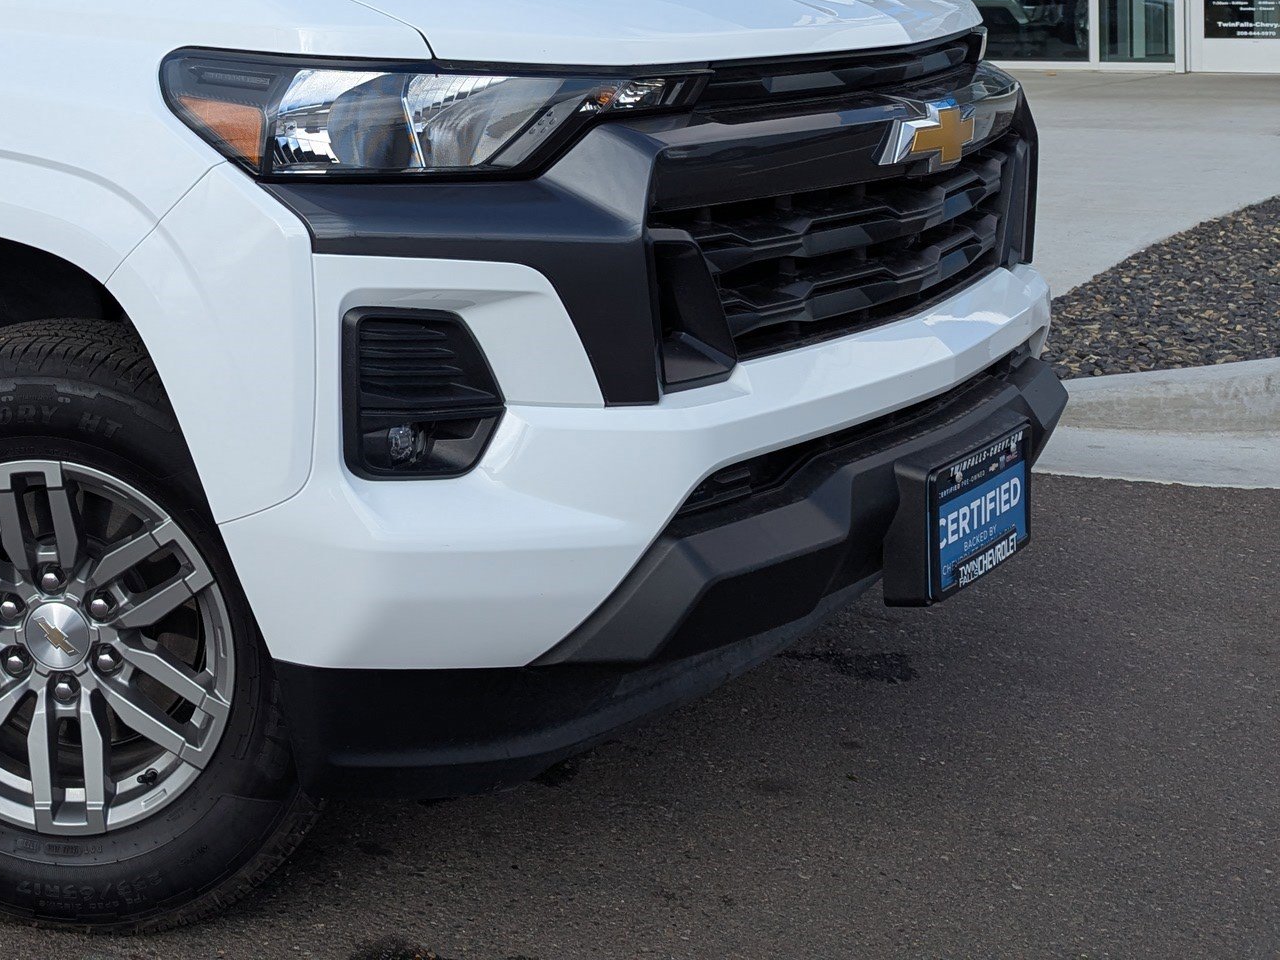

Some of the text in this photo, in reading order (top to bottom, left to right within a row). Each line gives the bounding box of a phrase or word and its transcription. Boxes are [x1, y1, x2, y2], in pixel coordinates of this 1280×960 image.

[963, 523, 998, 552] BACKED BY
[977, 532, 1018, 576] CHEVROLET
[958, 557, 980, 579] TWIN
[958, 567, 979, 588] FALLS
